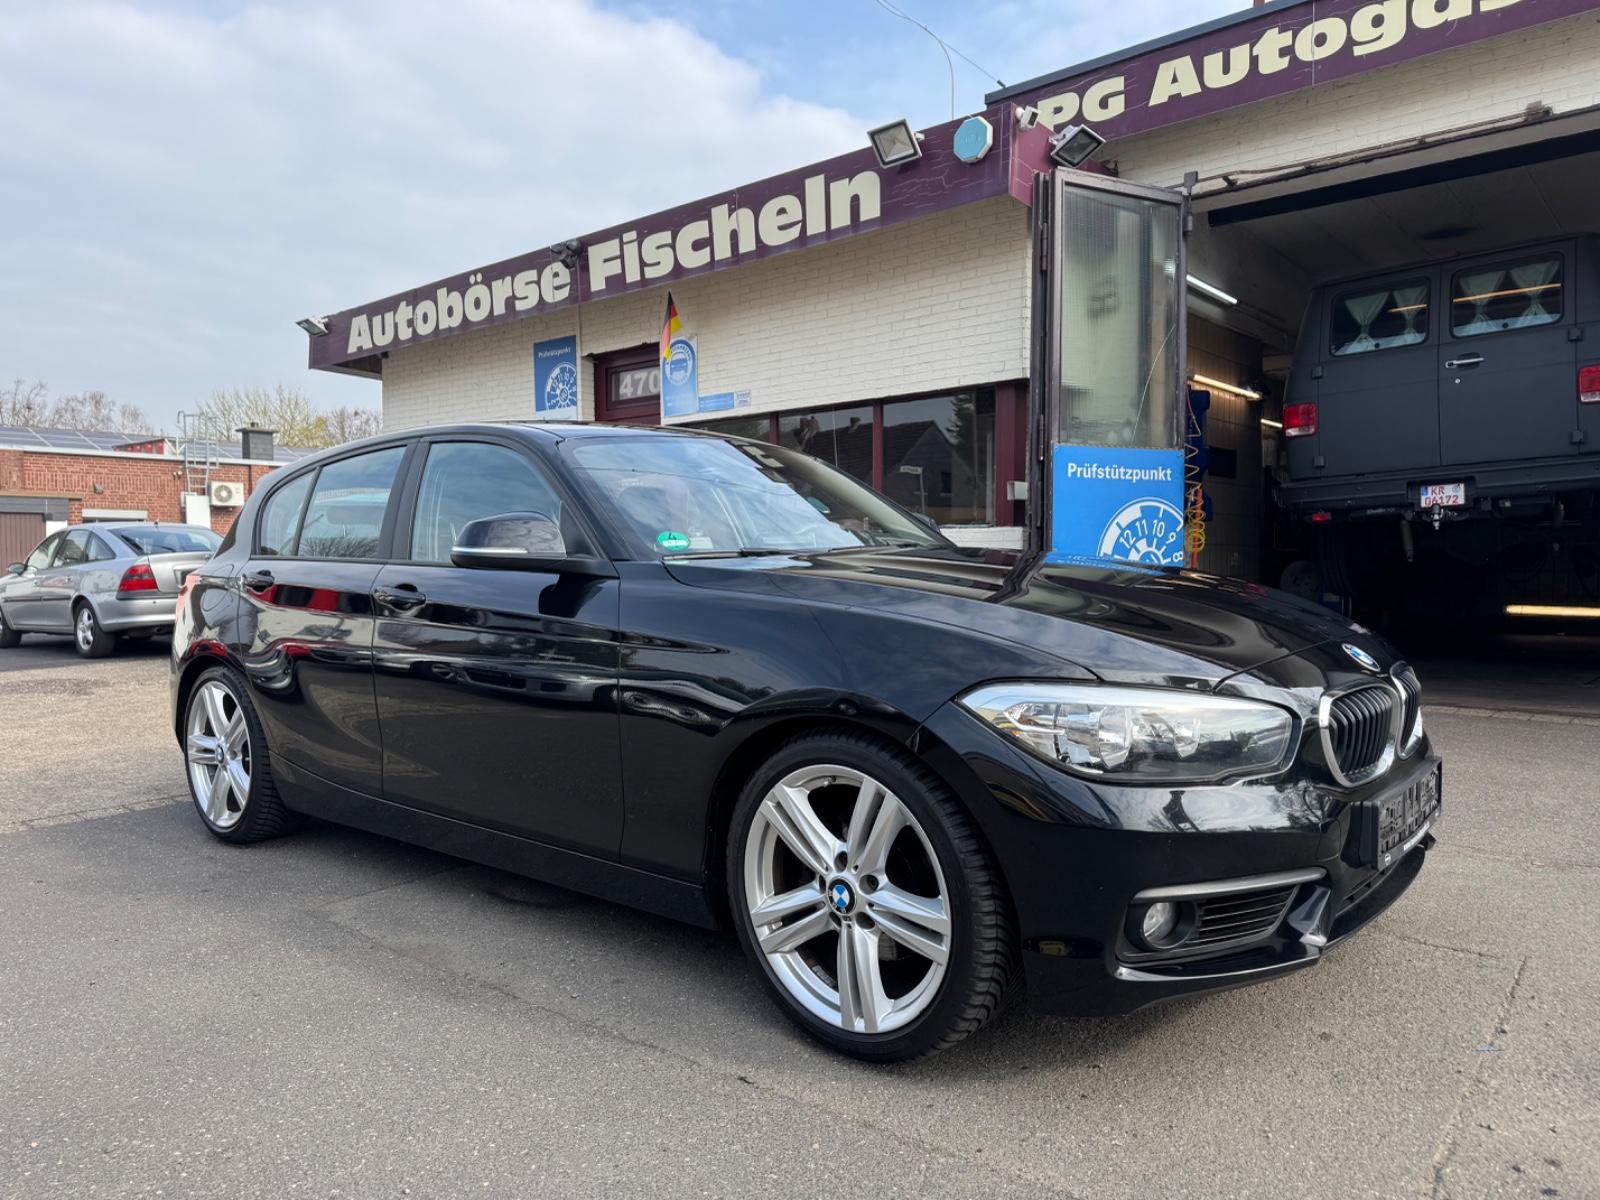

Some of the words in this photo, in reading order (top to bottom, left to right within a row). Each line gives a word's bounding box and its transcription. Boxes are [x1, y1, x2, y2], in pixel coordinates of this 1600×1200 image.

[1148, 0, 1521, 107] Autoga
[347, 261, 571, 353] Autobörse
[588, 170, 880, 292] Fischeln
[619, 370, 660, 398] 470
[1067, 462, 1172, 483] Prüfstützpunkt
[1431, 486, 1445, 496] KR
[1120, 529, 1136, 549] 12
[1136, 519, 1148, 537] 11
[1152, 519, 1165, 537] 10
[1166, 532, 1176, 544] 9
[1173, 551, 1184, 562] 8
